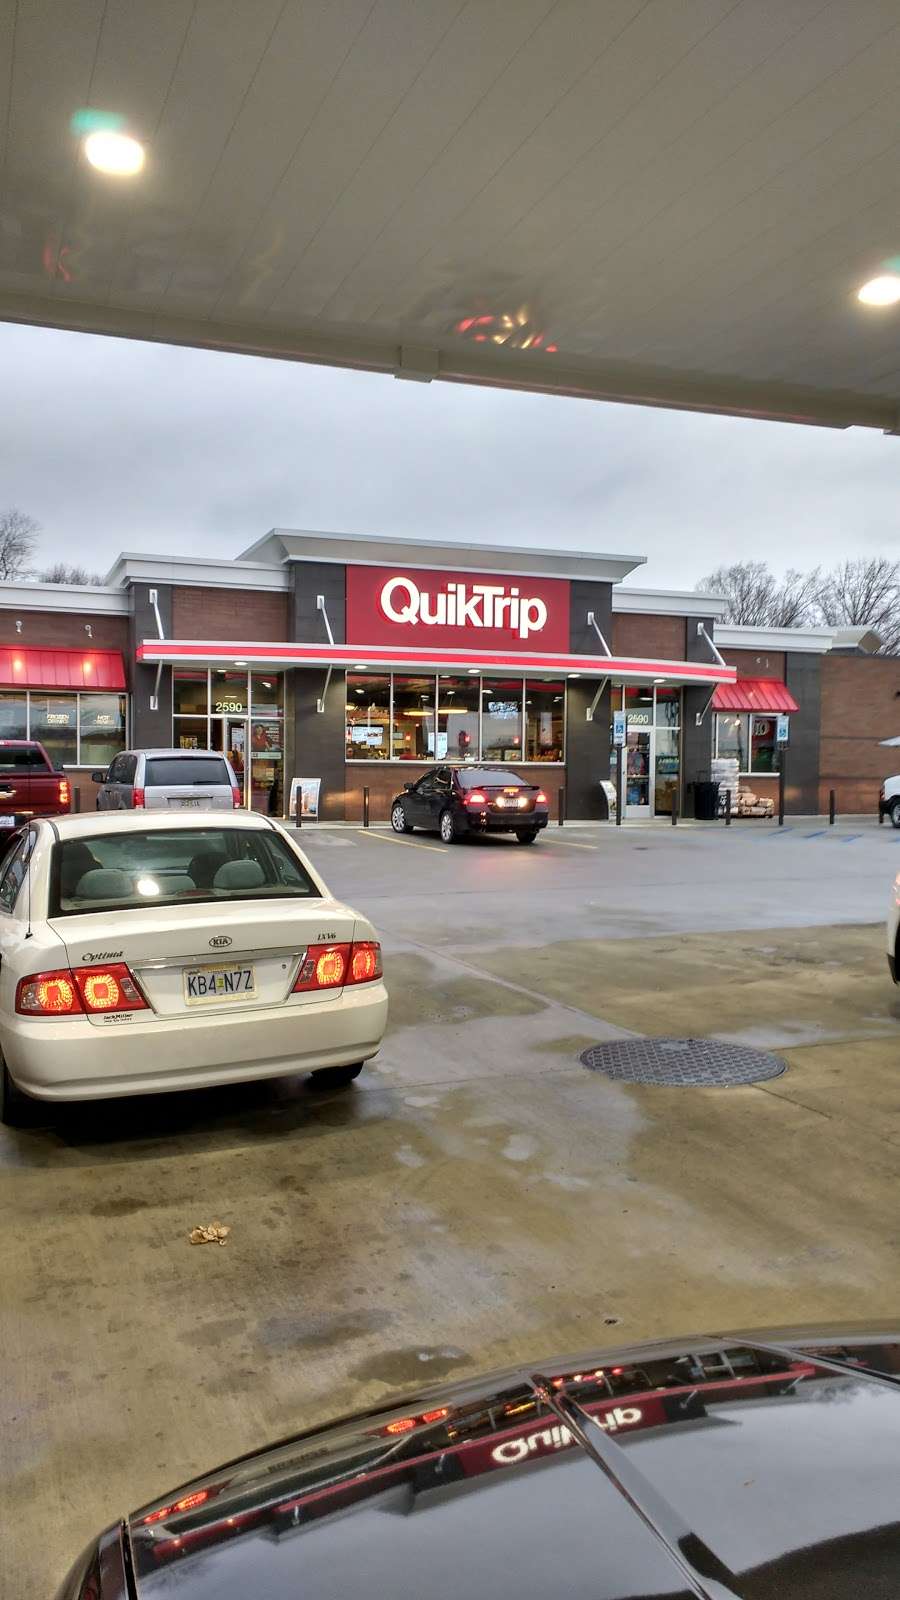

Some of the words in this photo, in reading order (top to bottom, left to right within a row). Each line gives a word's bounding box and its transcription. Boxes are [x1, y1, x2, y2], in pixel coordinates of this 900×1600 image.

[380, 576, 548, 639] QuikTrip
[215, 702, 243, 713] 2590
[82, 951, 124, 962] Optima
